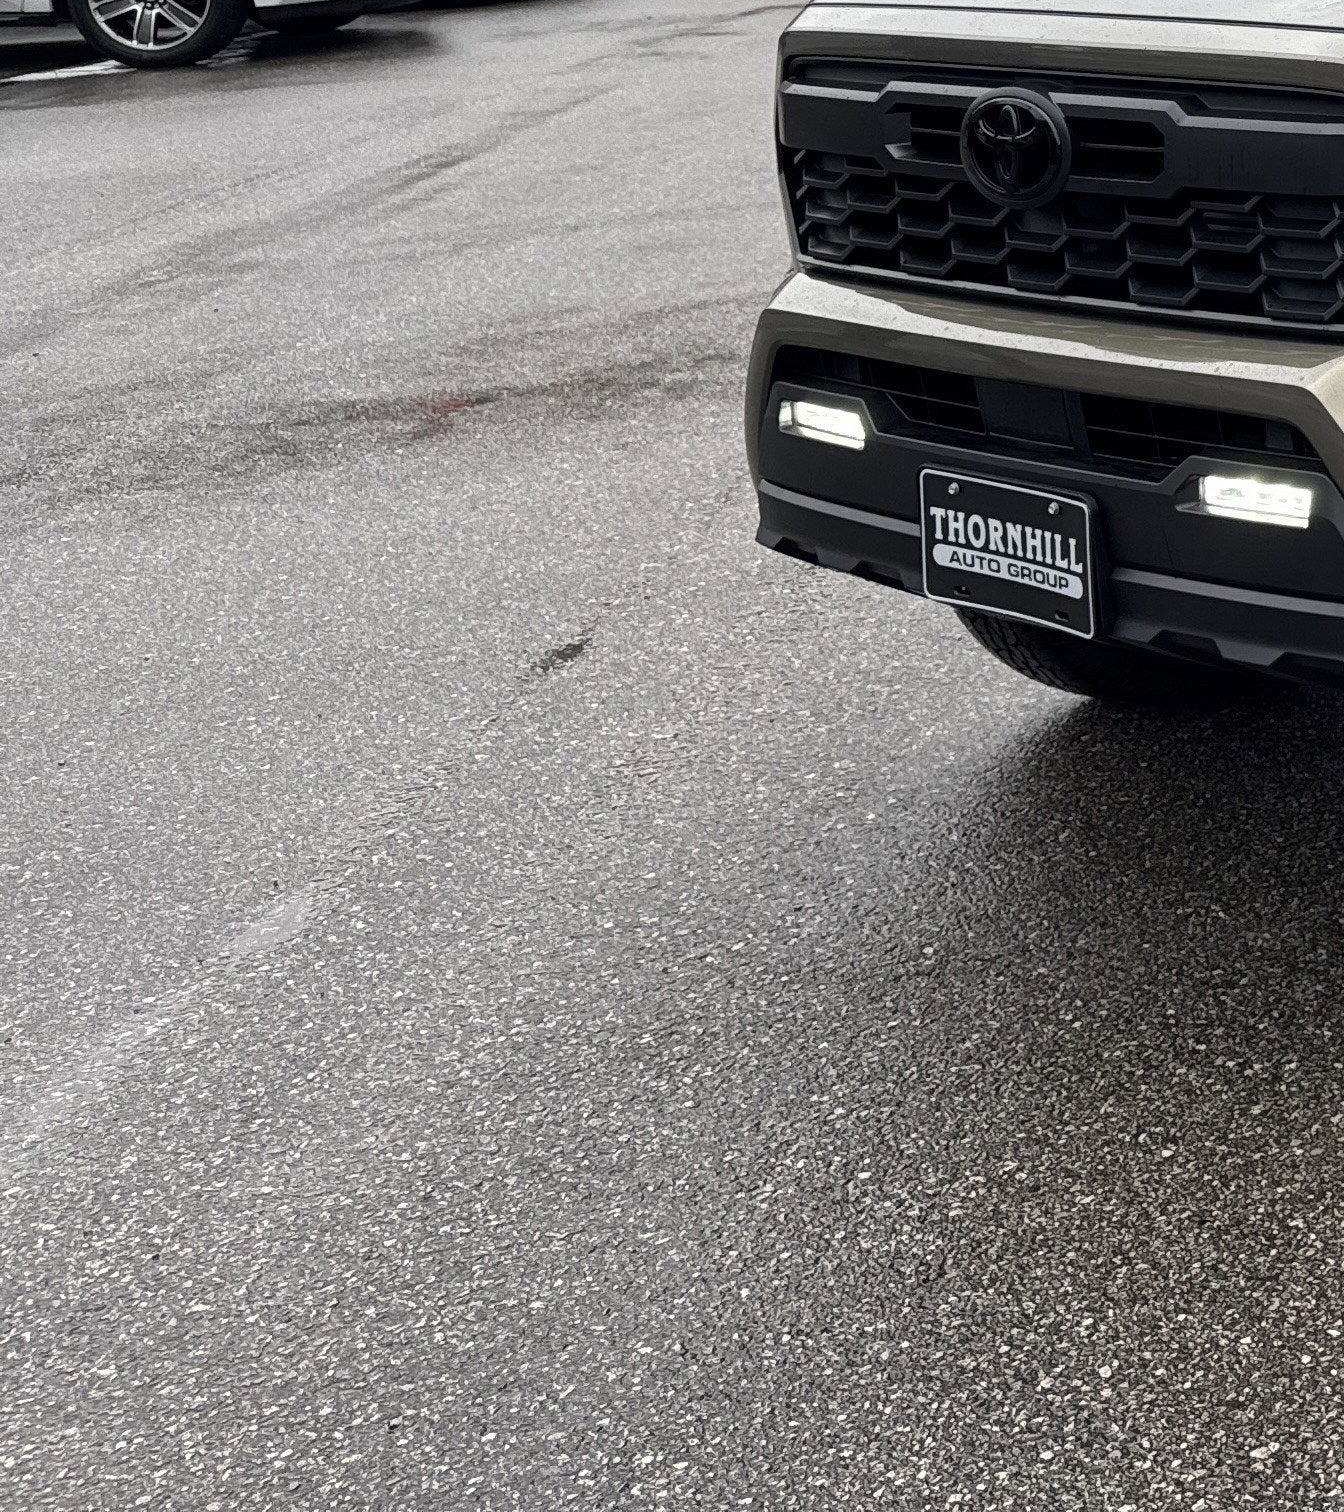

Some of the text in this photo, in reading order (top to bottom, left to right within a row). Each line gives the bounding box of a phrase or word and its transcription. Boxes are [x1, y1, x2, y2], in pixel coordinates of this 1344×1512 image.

[929, 506, 1083, 574] THORNHILL
[949, 550, 1069, 590] AUTO GROUP
